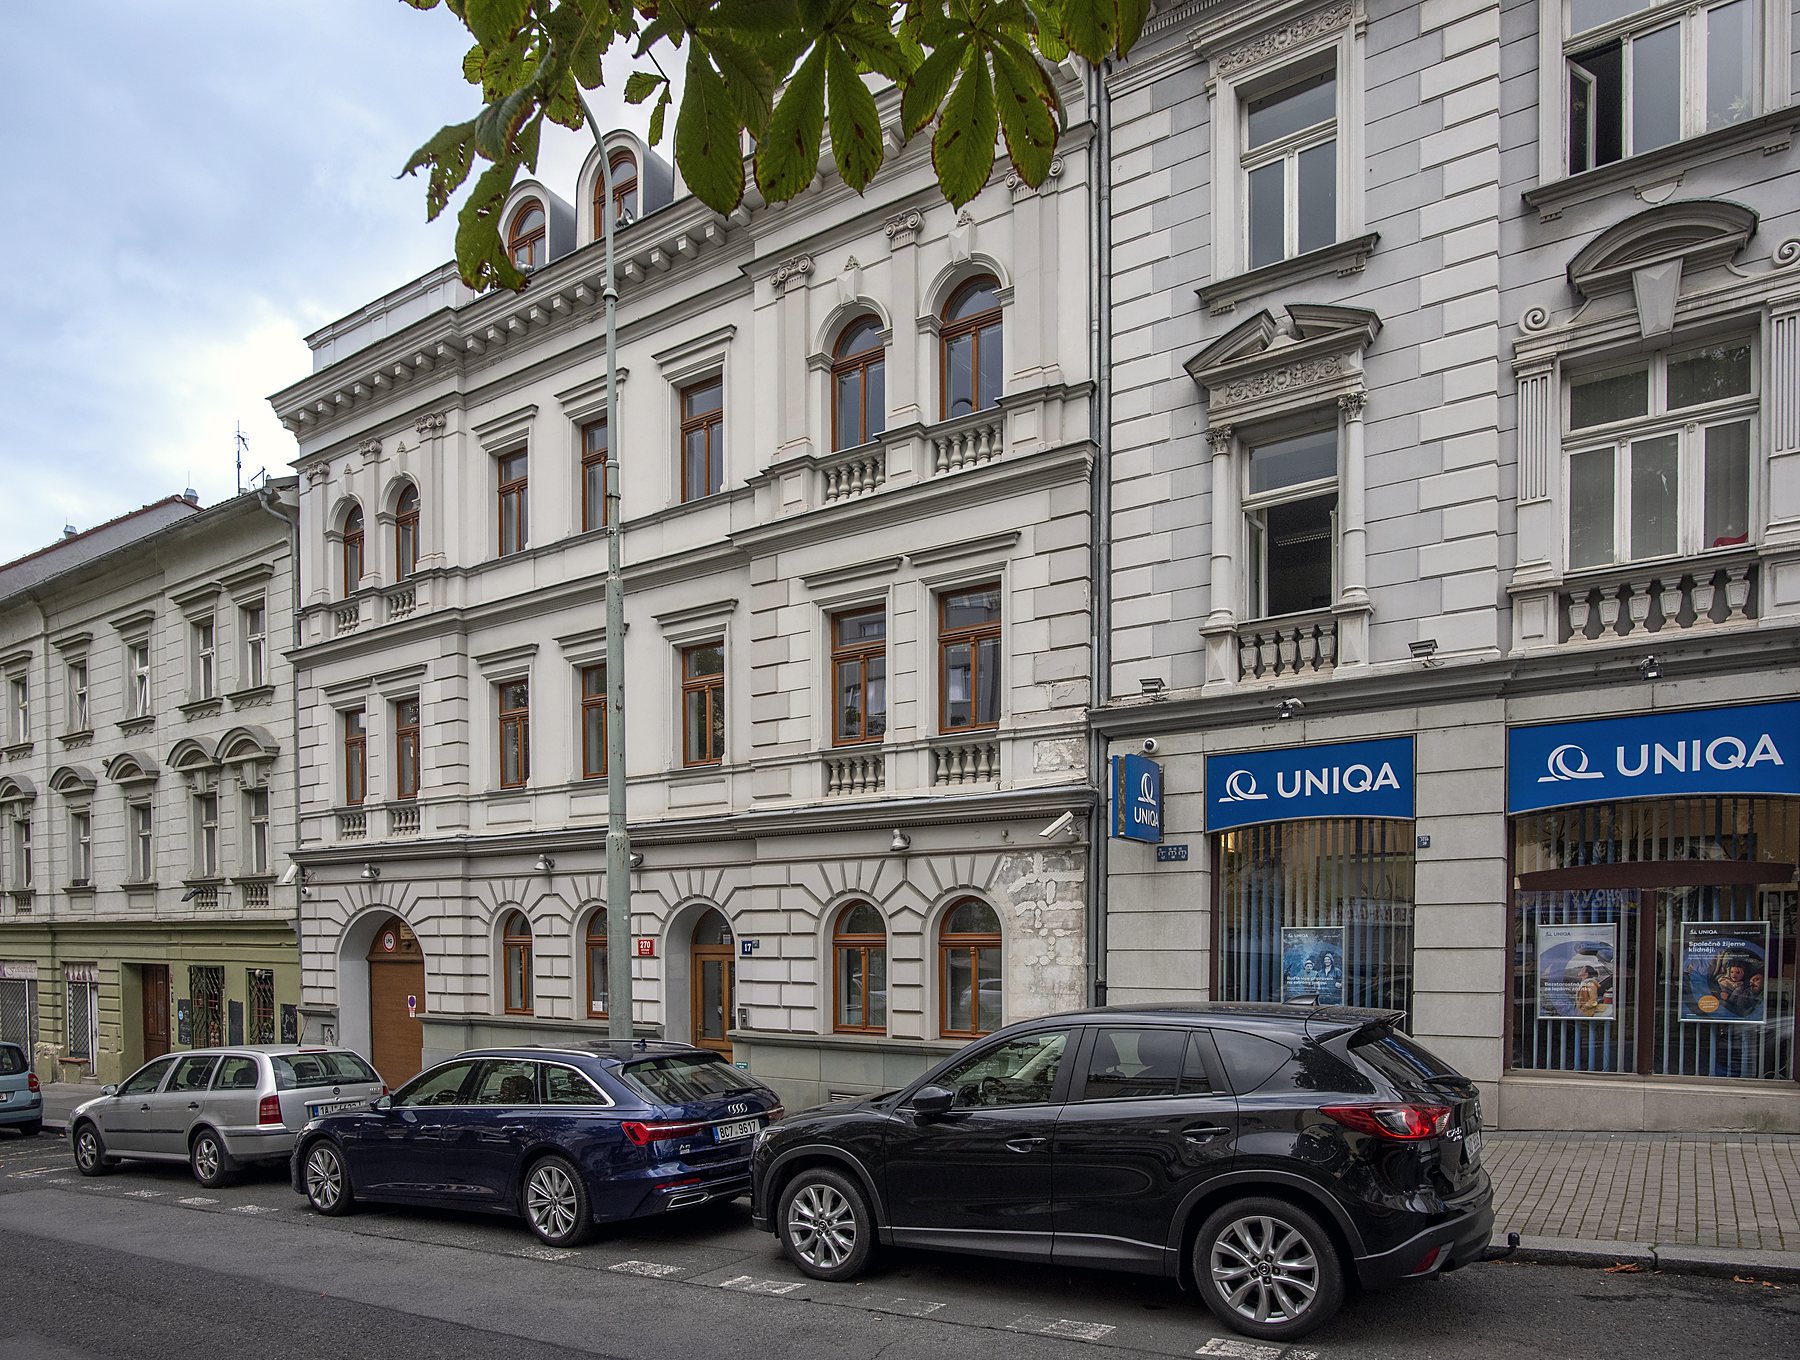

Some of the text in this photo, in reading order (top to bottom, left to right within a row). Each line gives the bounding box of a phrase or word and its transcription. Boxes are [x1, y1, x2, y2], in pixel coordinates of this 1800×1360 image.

[1616, 733, 1784, 777] UNIQA
[1277, 762, 1400, 798] UNIQA
[1134, 806, 1159, 828] UNIQA
[640, 941, 651, 949] 270
[744, 943, 752, 952] 17
[719, 1121, 756, 1138] 8C7 9617
